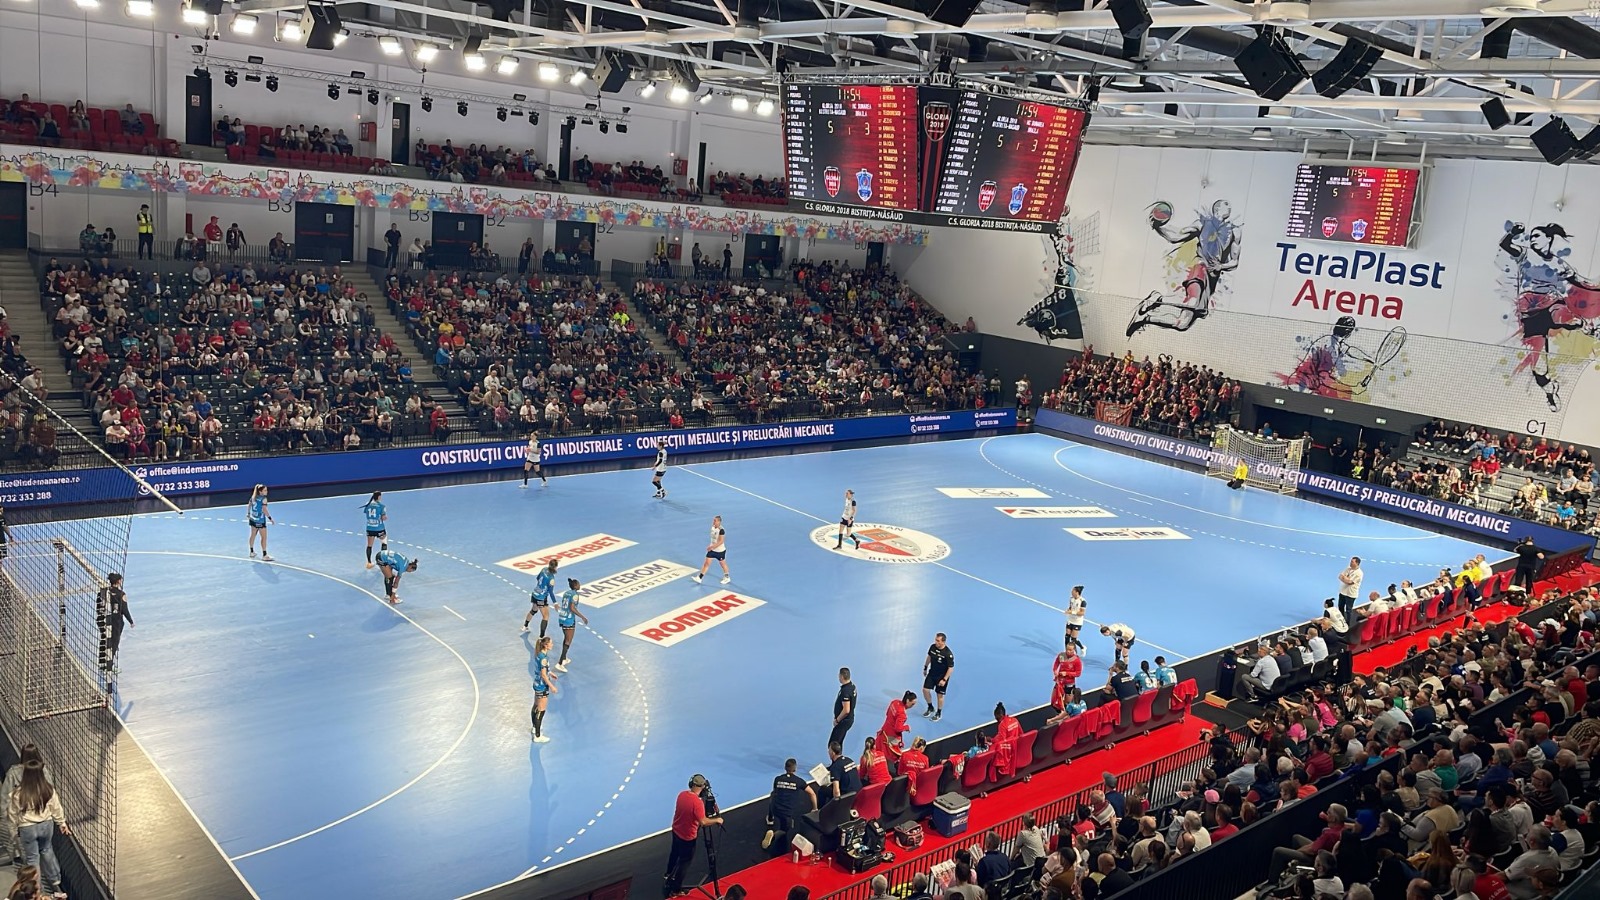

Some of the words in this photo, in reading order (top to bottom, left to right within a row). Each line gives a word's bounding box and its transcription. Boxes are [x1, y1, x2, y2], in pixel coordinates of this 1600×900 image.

[838, 88, 861, 102] 11:54
[1016, 104, 1038, 118] 11:54
[827, 120, 834, 134] 5
[864, 122, 870, 135] 3
[997, 134, 1004, 147] 5
[1031, 139, 1038, 152] 3
[1346, 169, 1367, 177] 11:54
[30, 180, 60, 197] B4
[1333, 188, 1338, 197] 5
[1366, 190, 1371, 199] 3
[269, 198, 292, 213] B3
[816, 204, 836, 213] GLORIA
[836, 206, 850, 215] 2018
[409, 209, 430, 222] B3
[960, 219, 980, 227] GLORIA
[1276, 242, 1446, 289] TeraPlast
[1292, 279, 1404, 320] Arena
[1526, 419, 1546, 435] C1
[422, 448, 501, 466] CONSTRUCȚII
[543, 444, 553, 460] ȘI
[557, 439, 623, 456] INDUSTRIALE
[688, 431, 730, 445] METALICE
[743, 425, 792, 441] PRELUCRĂRI
[794, 424, 834, 437] MECANICE
[150, 464, 238, 476] office@indemanarea.ro
[154, 482, 174, 491] 0732
[177, 481, 193, 490] 333
[194, 480, 210, 489] 388
[1094, 425, 1146, 446] CONSTRUCȚII
[1148, 437, 1174, 452] CIVILE
[1186, 446, 1238, 467] INDUSTRIAL
[1309, 470, 1359, 496] METALICE
[1374, 490, 1444, 518] PRELUCRĂRI
[1446, 506, 1511, 534] MECANICE
[19, 493, 33, 501] 333
[368, 508, 377, 518] 14
[512, 536, 622, 570] SUPERBET
[579, 564, 670, 598] MATEROM
[609, 572, 680, 600] AUTOMOTIVE
[639, 594, 747, 642] ROMBAT
[1085, 830, 1094, 839] 17
